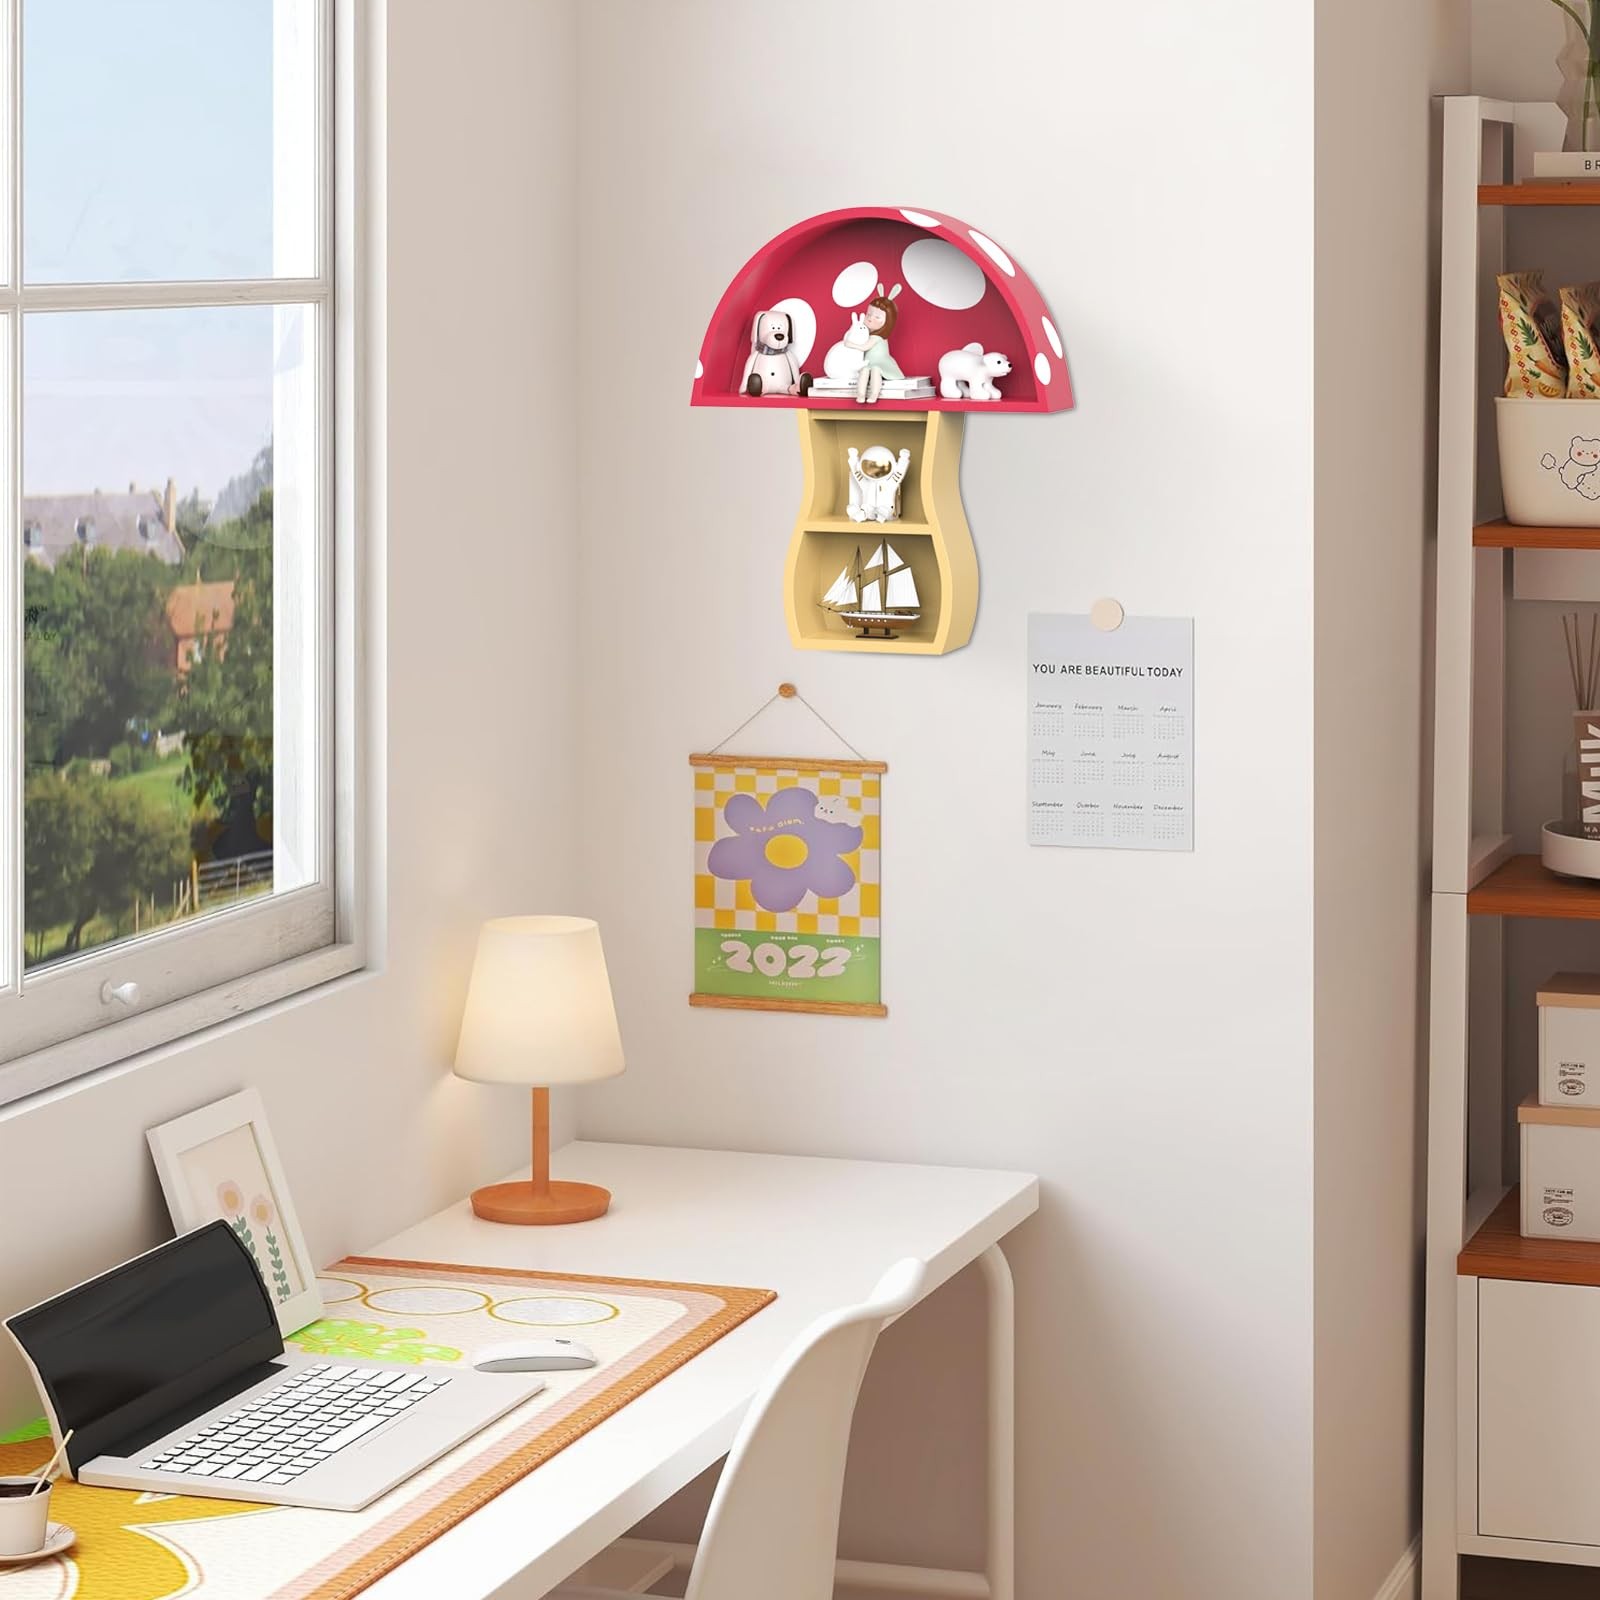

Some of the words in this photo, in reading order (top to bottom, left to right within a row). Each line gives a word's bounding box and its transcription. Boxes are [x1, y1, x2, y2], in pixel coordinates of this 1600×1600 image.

[1032, 664, 1056, 674] YOU
[1060, 665, 1082, 675] ARE
[1085, 665, 1145, 677] BEAUTIFUL
[1147, 667, 1184, 677] TODAY
[720, 940, 852, 978] 2022
